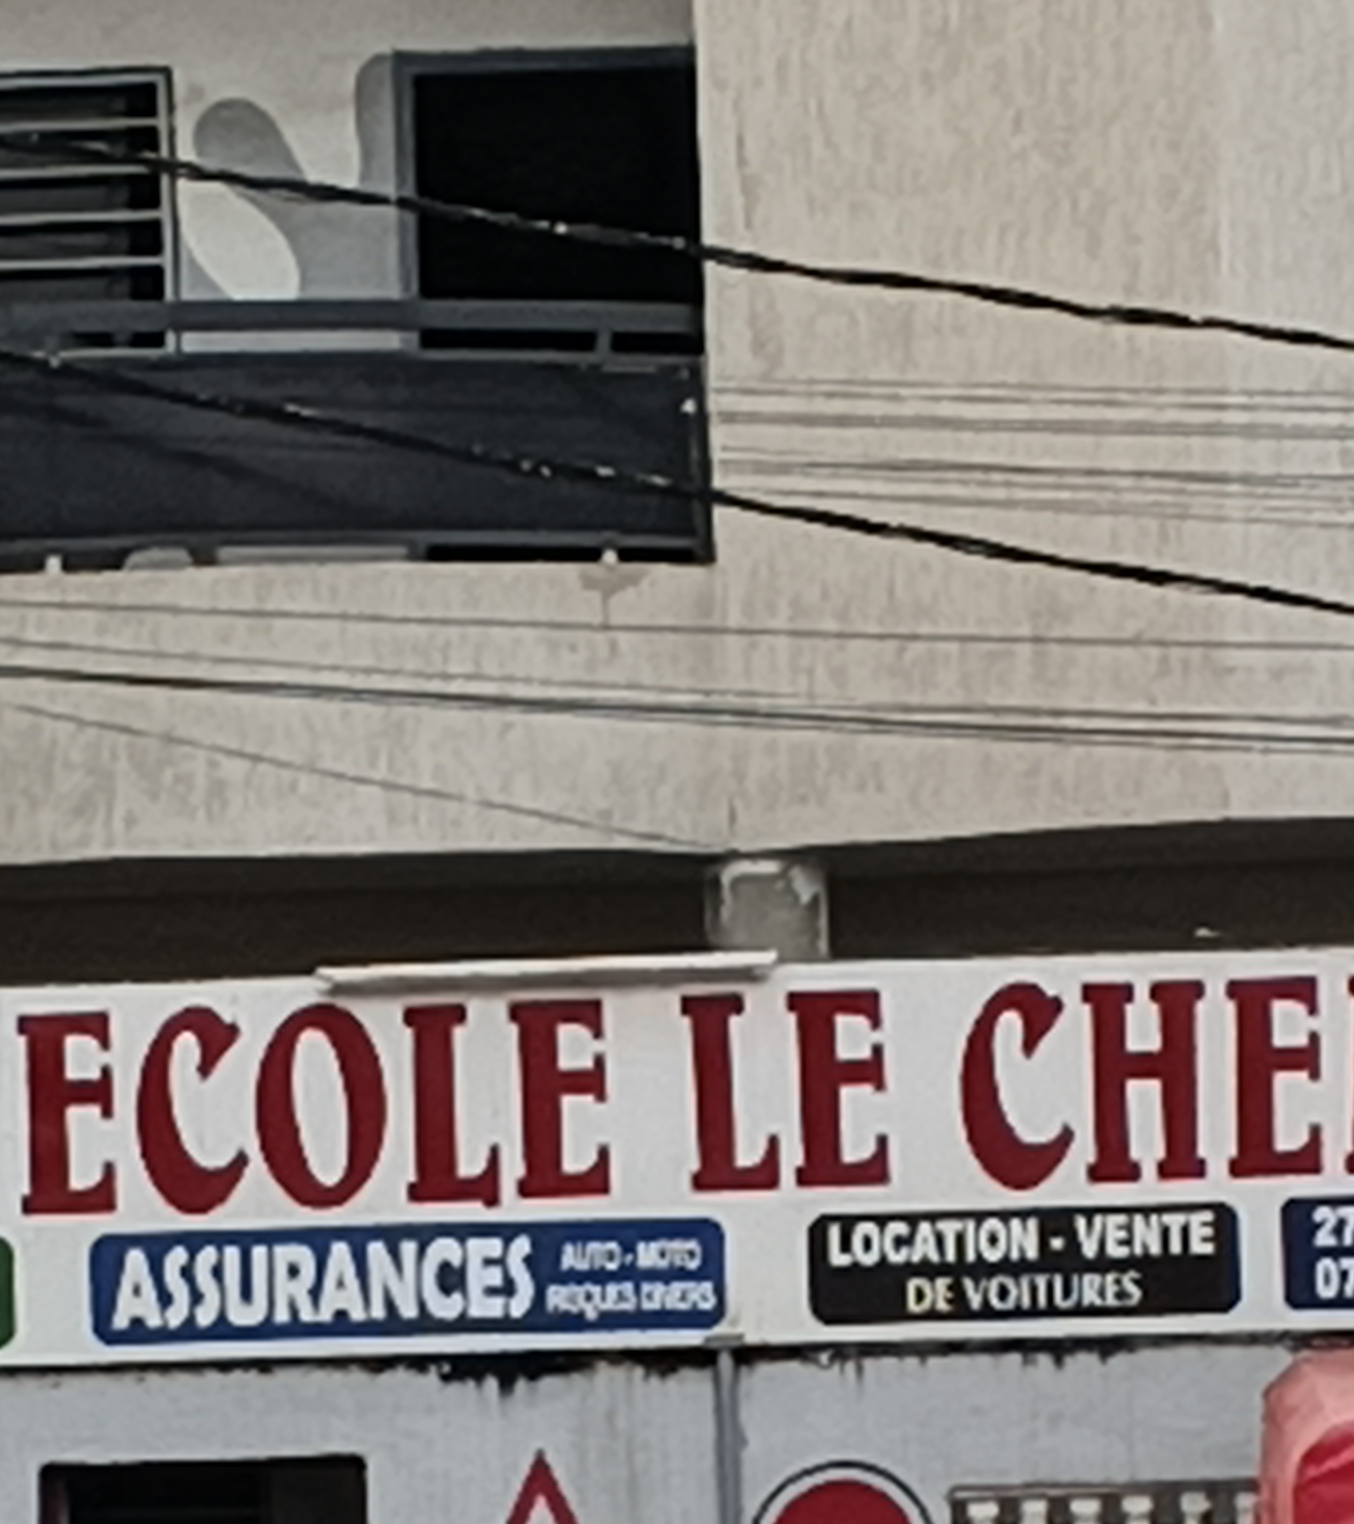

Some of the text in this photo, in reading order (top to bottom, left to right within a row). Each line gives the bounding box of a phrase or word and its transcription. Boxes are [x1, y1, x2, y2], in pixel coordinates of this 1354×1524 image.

[17, 1003, 612, 1215] ECOLE
[680, 990, 891, 1192] LE
[828, 1217, 1038, 1267] LOCATION
[1073, 1210, 1215, 1257] VENTE
[111, 1236, 534, 1331] ASSURANCES
[906, 1270, 1142, 1314] DE VOITURES
